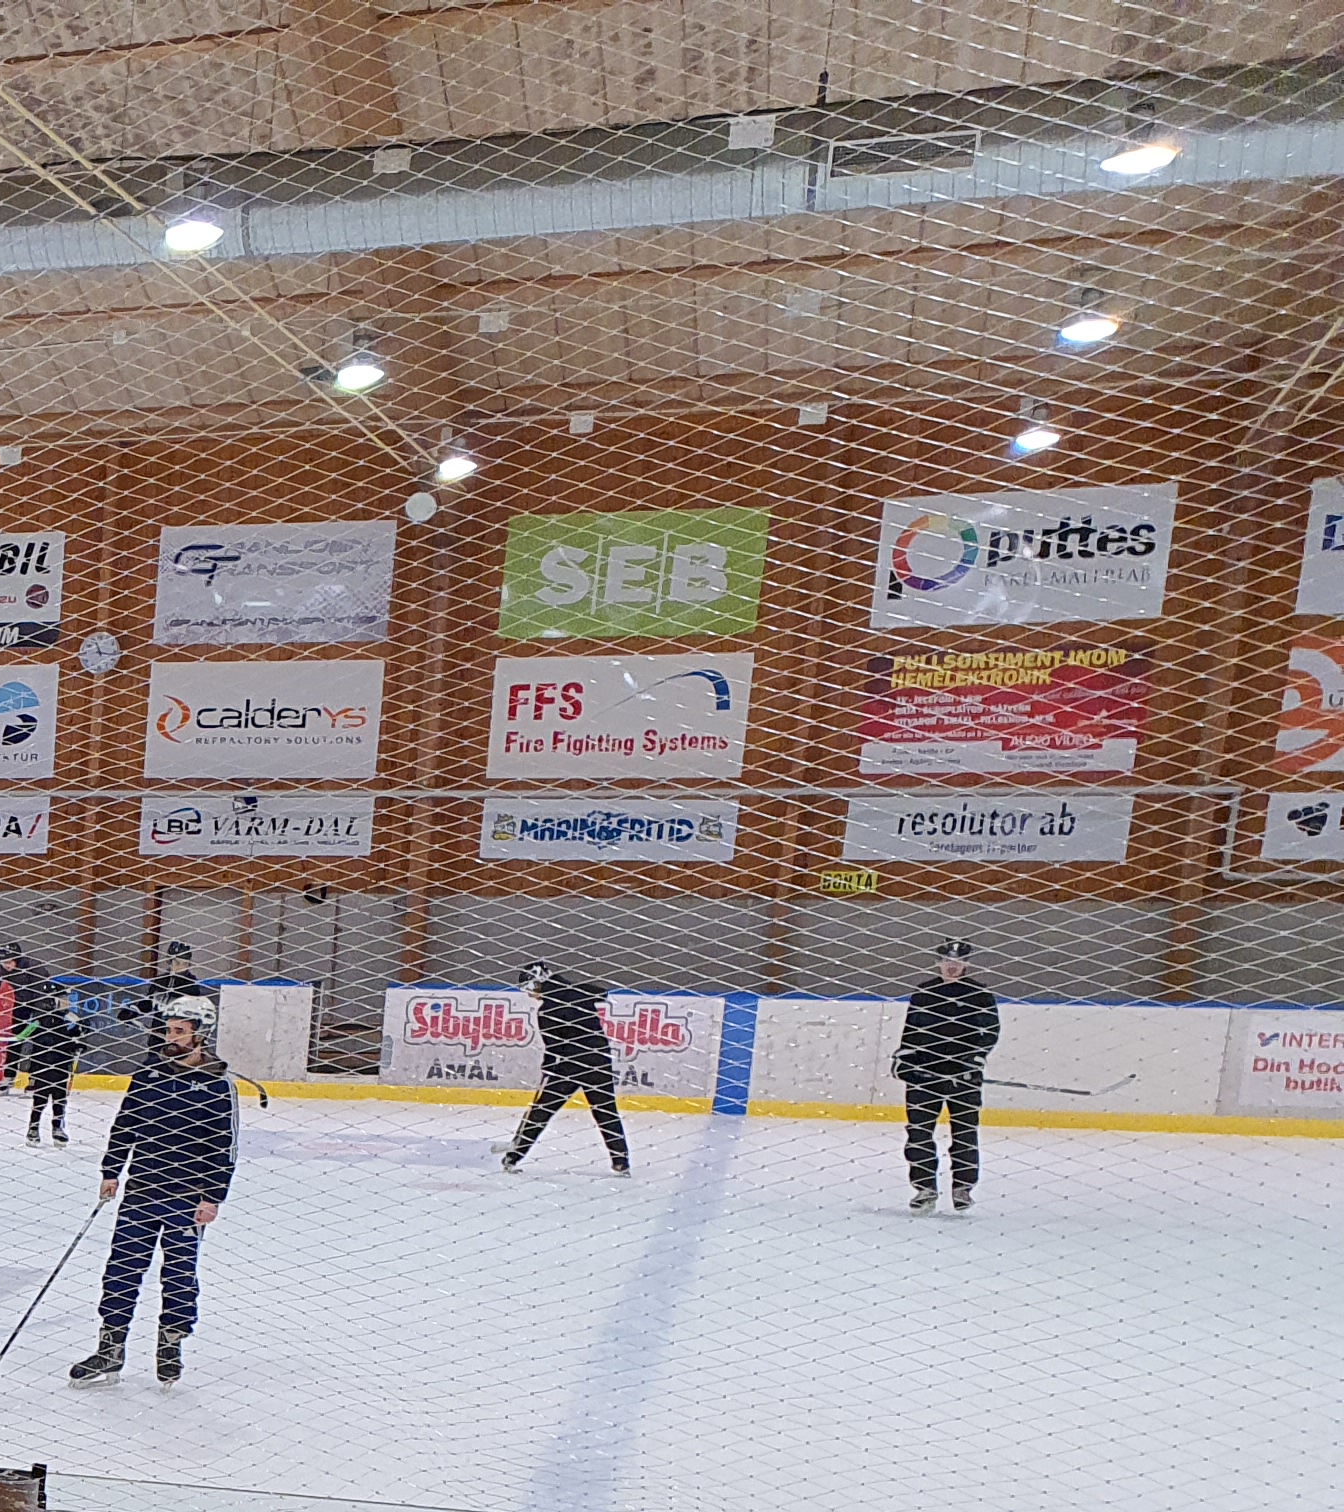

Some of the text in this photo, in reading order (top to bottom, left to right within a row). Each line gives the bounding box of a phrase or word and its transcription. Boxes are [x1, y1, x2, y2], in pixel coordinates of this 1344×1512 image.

[987, 515, 1157, 567] puttes
[534, 543, 728, 605] SEB
[506, 682, 583, 721] FFS
[505, 730, 729, 756] Fire Fighting Systems
[1039, 802, 1077, 836] ab
[410, 1002, 527, 1051] Sibylla
[598, 1007, 685, 1056] bylla
[427, 1058, 498, 1081] ÅMÅL
[1253, 1057, 1290, 1072] Din
